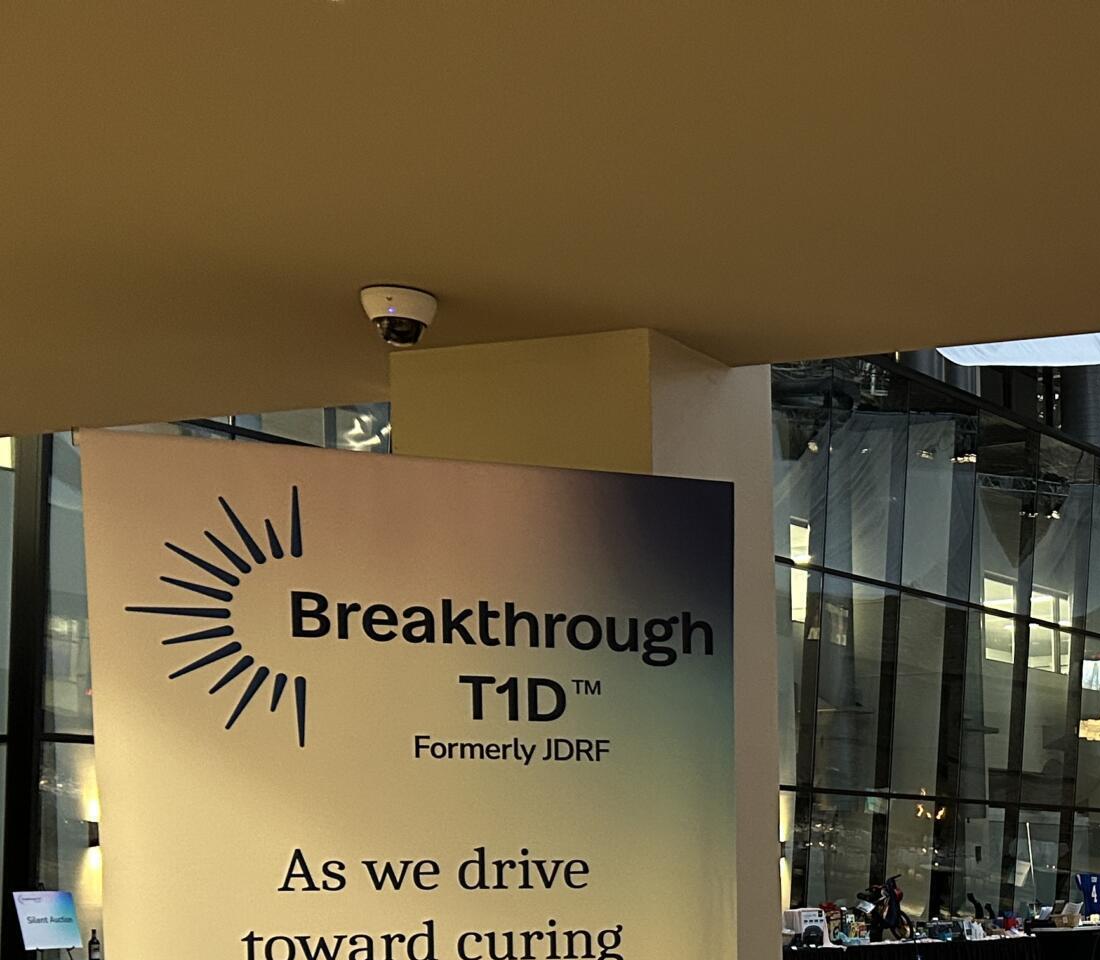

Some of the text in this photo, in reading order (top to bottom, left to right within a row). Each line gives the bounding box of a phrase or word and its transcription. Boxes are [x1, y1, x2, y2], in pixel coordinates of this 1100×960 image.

[290, 590, 714, 667] Breakthrough
[414, 734, 610, 766] Formerly JDRF
[276, 846, 590, 892] As we drive
